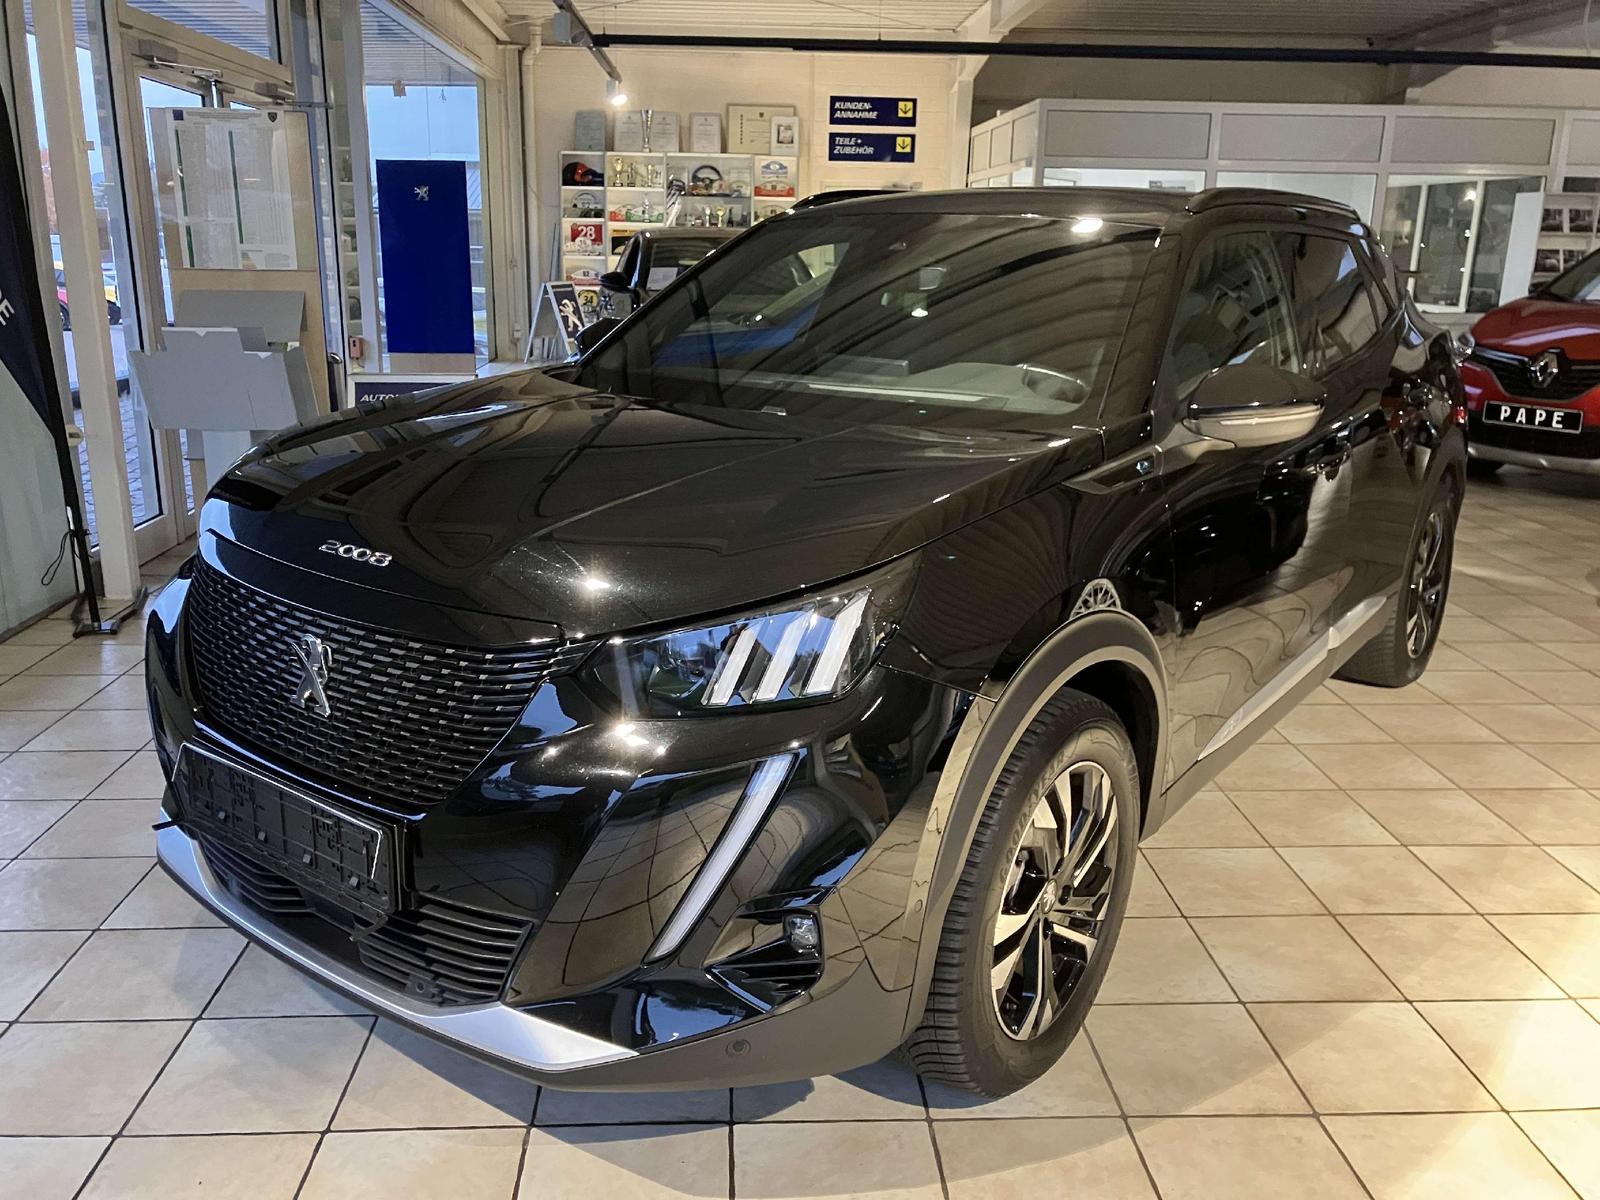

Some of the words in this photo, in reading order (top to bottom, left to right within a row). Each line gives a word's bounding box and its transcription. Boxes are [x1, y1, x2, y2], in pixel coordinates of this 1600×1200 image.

[834, 101, 872, 110] KUNDEN-
[833, 110, 879, 119] ANNAHME
[833, 145, 875, 154] ZUBEHÖR
[577, 225, 596, 240] 28
[1500, 405, 1565, 429] PAPE
[318, 539, 393, 567] 2008
